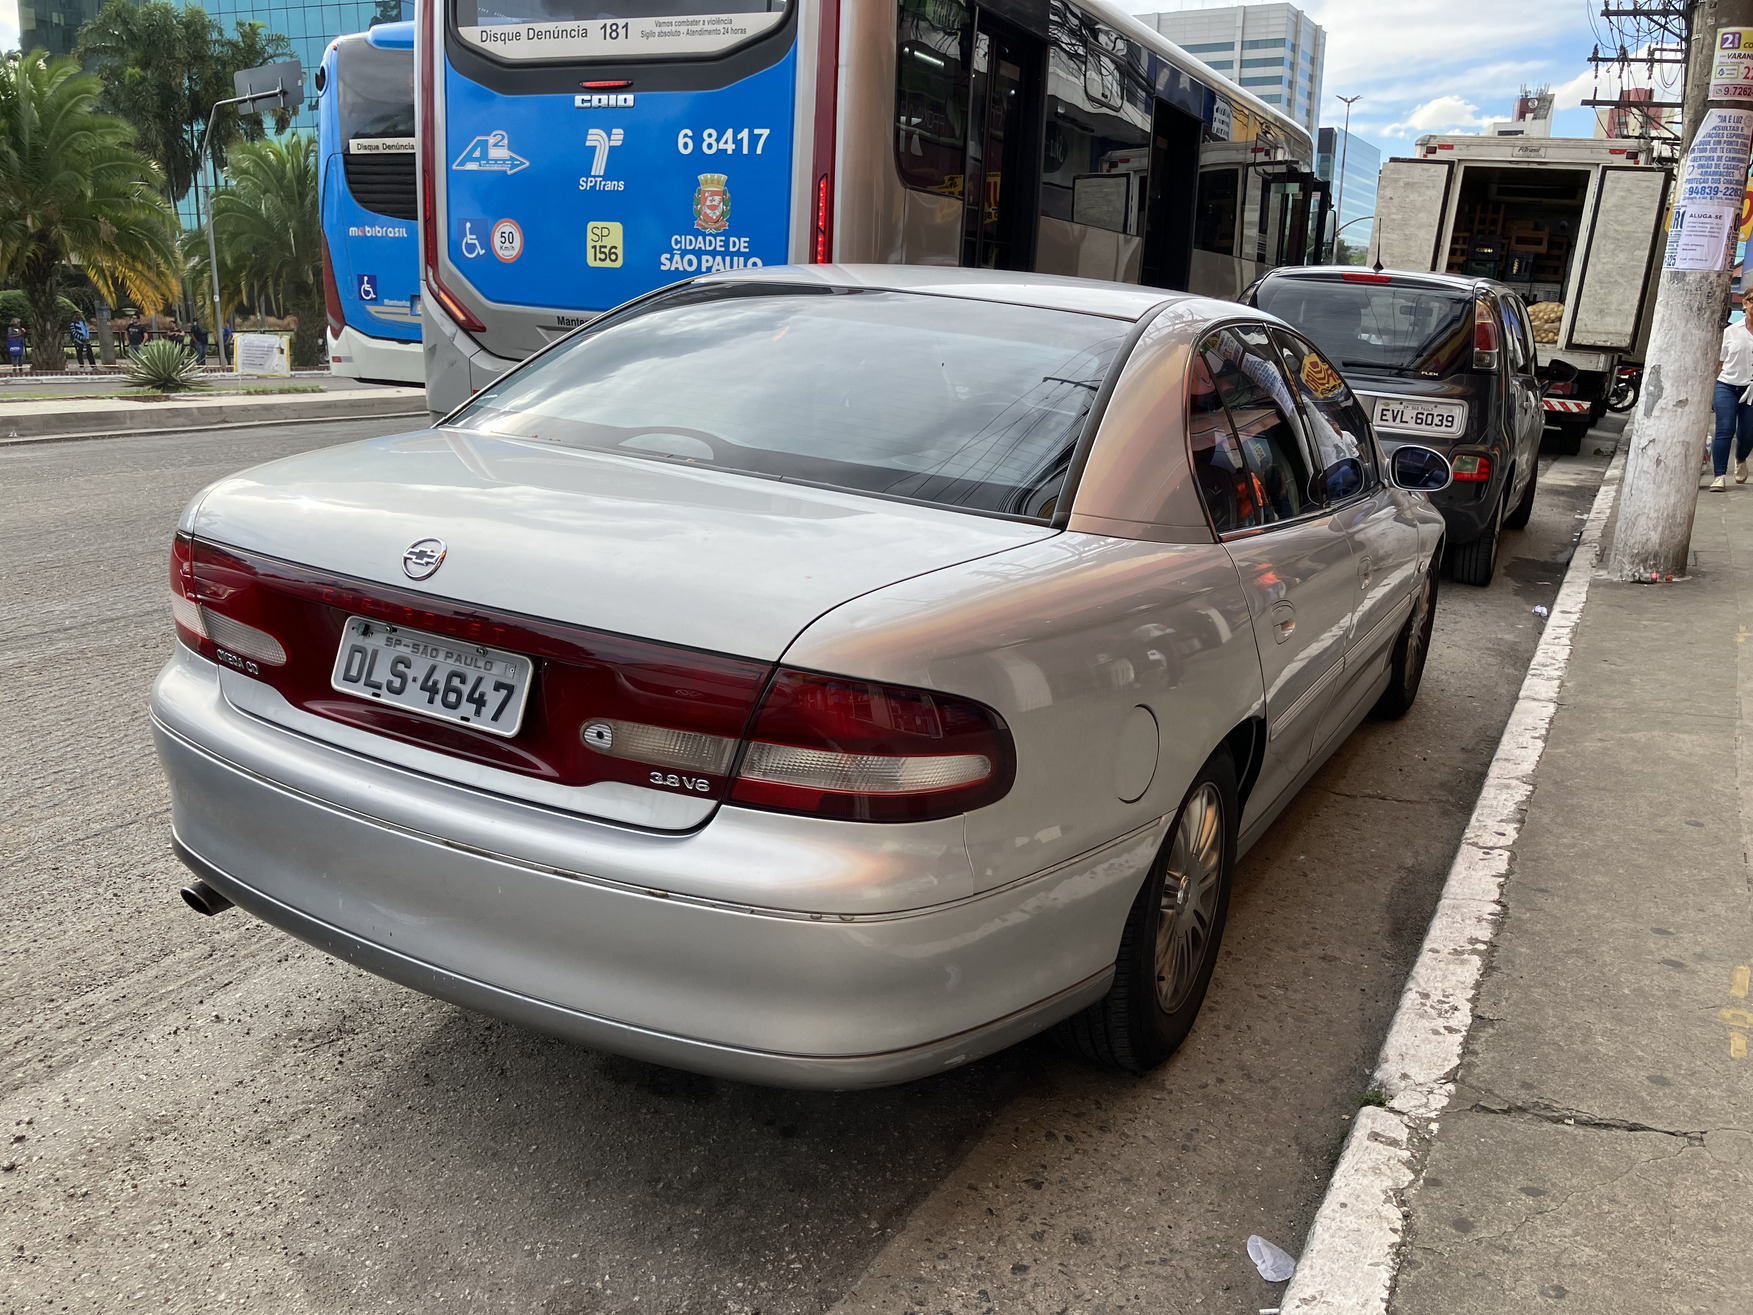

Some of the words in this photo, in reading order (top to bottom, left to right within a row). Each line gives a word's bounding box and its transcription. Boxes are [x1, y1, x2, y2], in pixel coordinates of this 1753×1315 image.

[654, 20, 673, 28] Vamos
[674, 18, 700, 26] combater
[706, 17, 732, 26] violência
[480, 30, 522, 44] Disque
[527, 26, 588, 40] Denúncia
[600, 22, 629, 40] 181
[640, 30, 656, 40] Sigilo
[658, 29, 680, 38] absoluto
[686, 28, 720, 36] Atendimento
[722, 27, 729, 35] 24
[730, 26, 746, 34] horas
[1722, 34, 1734, 48] 2
[356, 143, 380, 152] Disque
[382, 142, 415, 151] Denúncia
[678, 128, 694, 155] 6
[702, 128, 770, 155] 8417
[579, 177, 625, 191] SPTrans
[350, 226, 408, 237] mobibrasil
[500, 232, 514, 244] 50
[590, 226, 610, 243] SP
[671, 235, 725, 251] CIDADE
[729, 237, 750, 252] DE
[591, 244, 618, 263] 156
[660, 250, 698, 271] SÃO
[217, 649, 246, 670] OMEGA
[444, 651, 494, 672] PAULO
[650, 772, 680, 787] 3.8
[682, 776, 710, 792] V6
